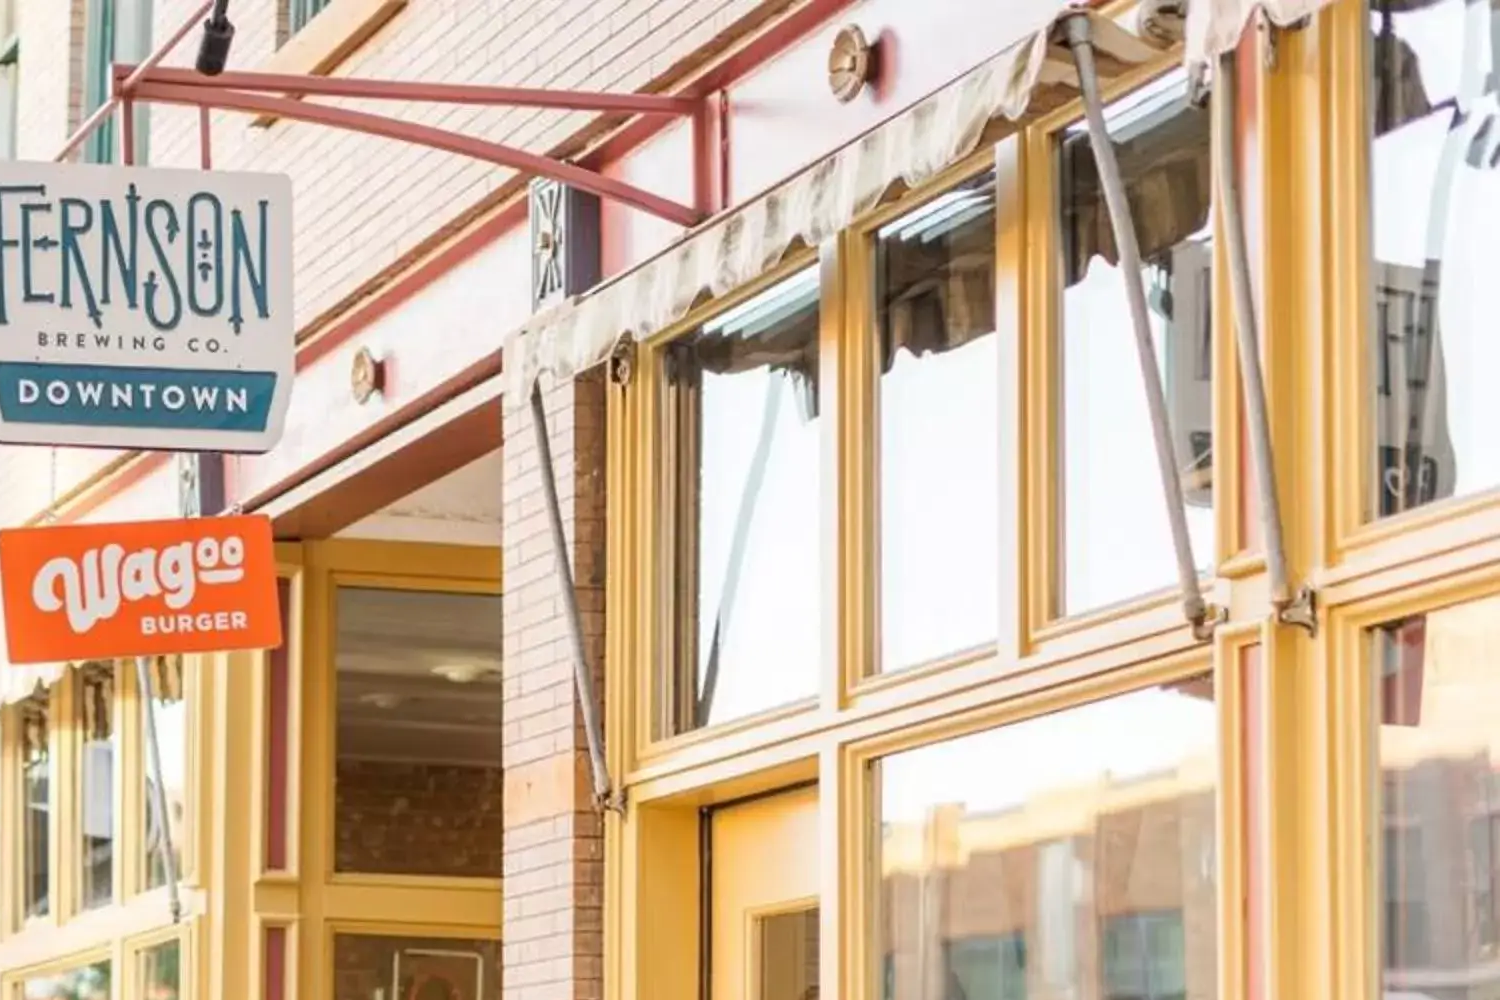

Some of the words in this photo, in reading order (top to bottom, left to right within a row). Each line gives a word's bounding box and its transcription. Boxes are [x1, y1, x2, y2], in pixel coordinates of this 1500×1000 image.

[37, 331, 167, 352] BREWING
[187, 337, 229, 354] CO.
[18, 378, 249, 414] DOWNTOWN
[32, 535, 245, 634] Wagoo
[140, 611, 249, 635] BURGER
